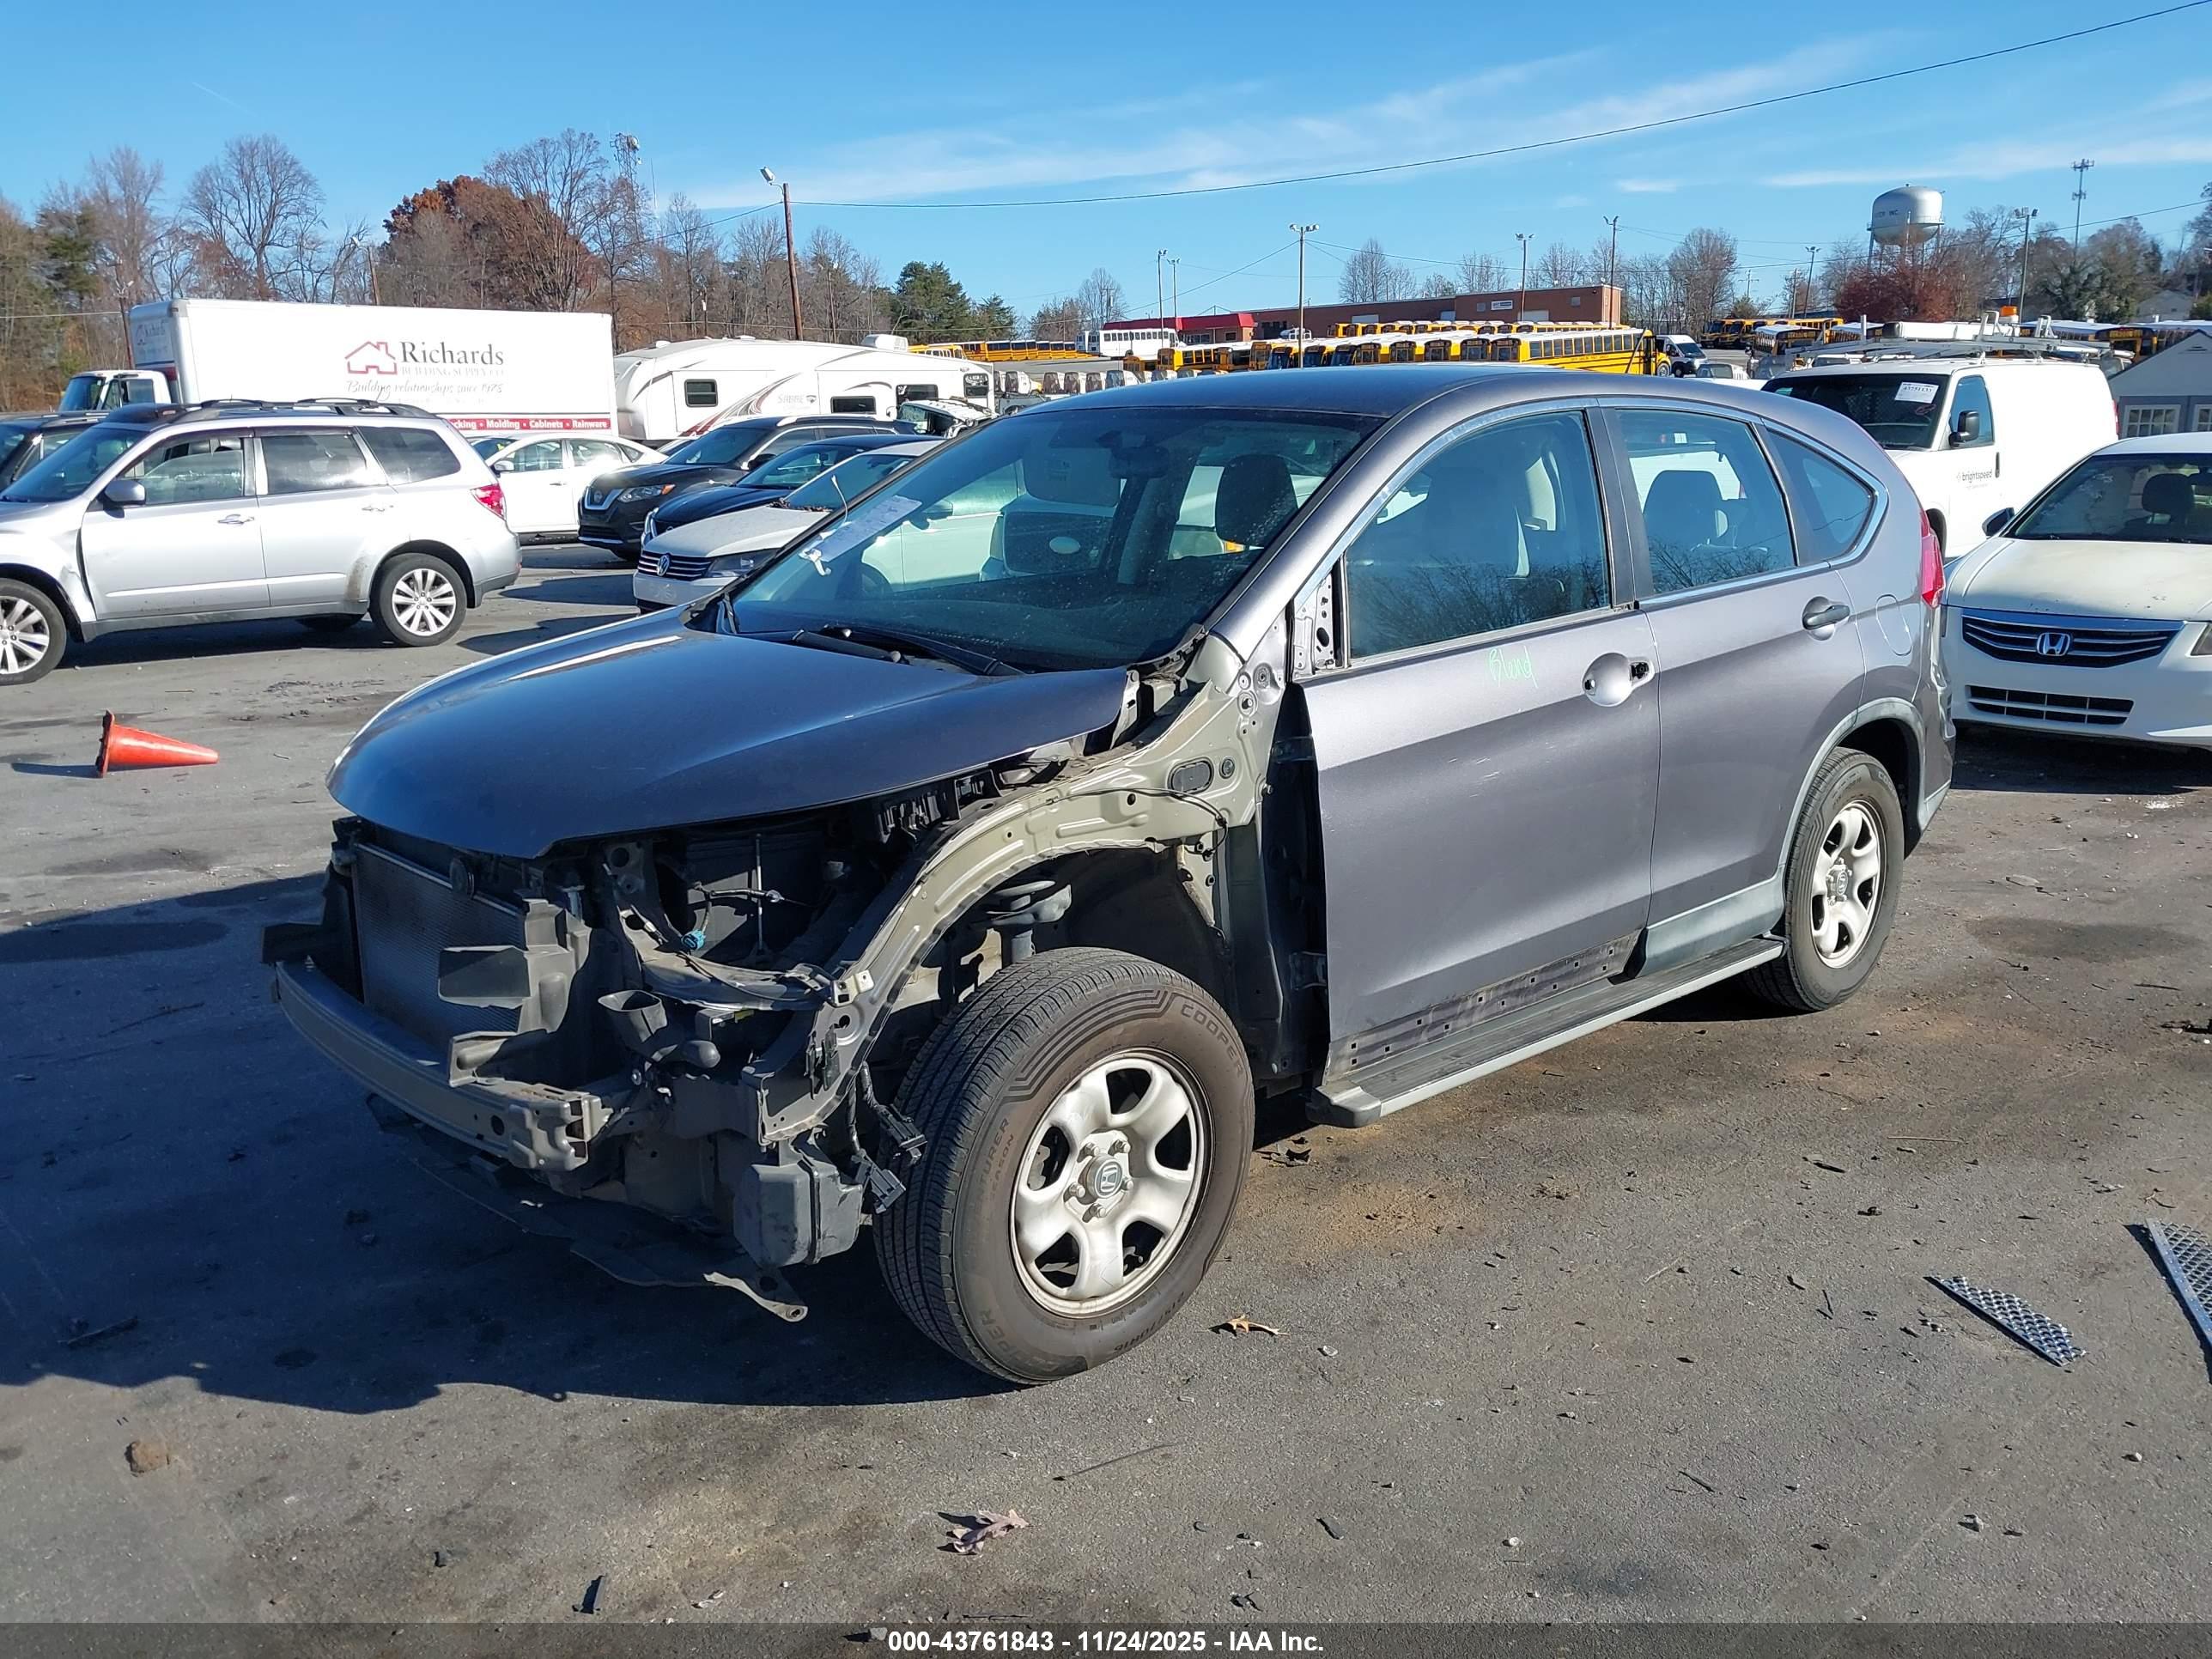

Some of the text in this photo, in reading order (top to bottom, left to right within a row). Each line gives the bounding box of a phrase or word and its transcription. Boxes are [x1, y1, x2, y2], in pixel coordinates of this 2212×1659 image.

[399, 341, 504, 366] Richards
[486, 419, 520, 430] Molding
[528, 419, 564, 429] Cabinets
[1961, 468, 1993, 483] brightspeed
[1181, 1003, 1244, 1078] COOPER
